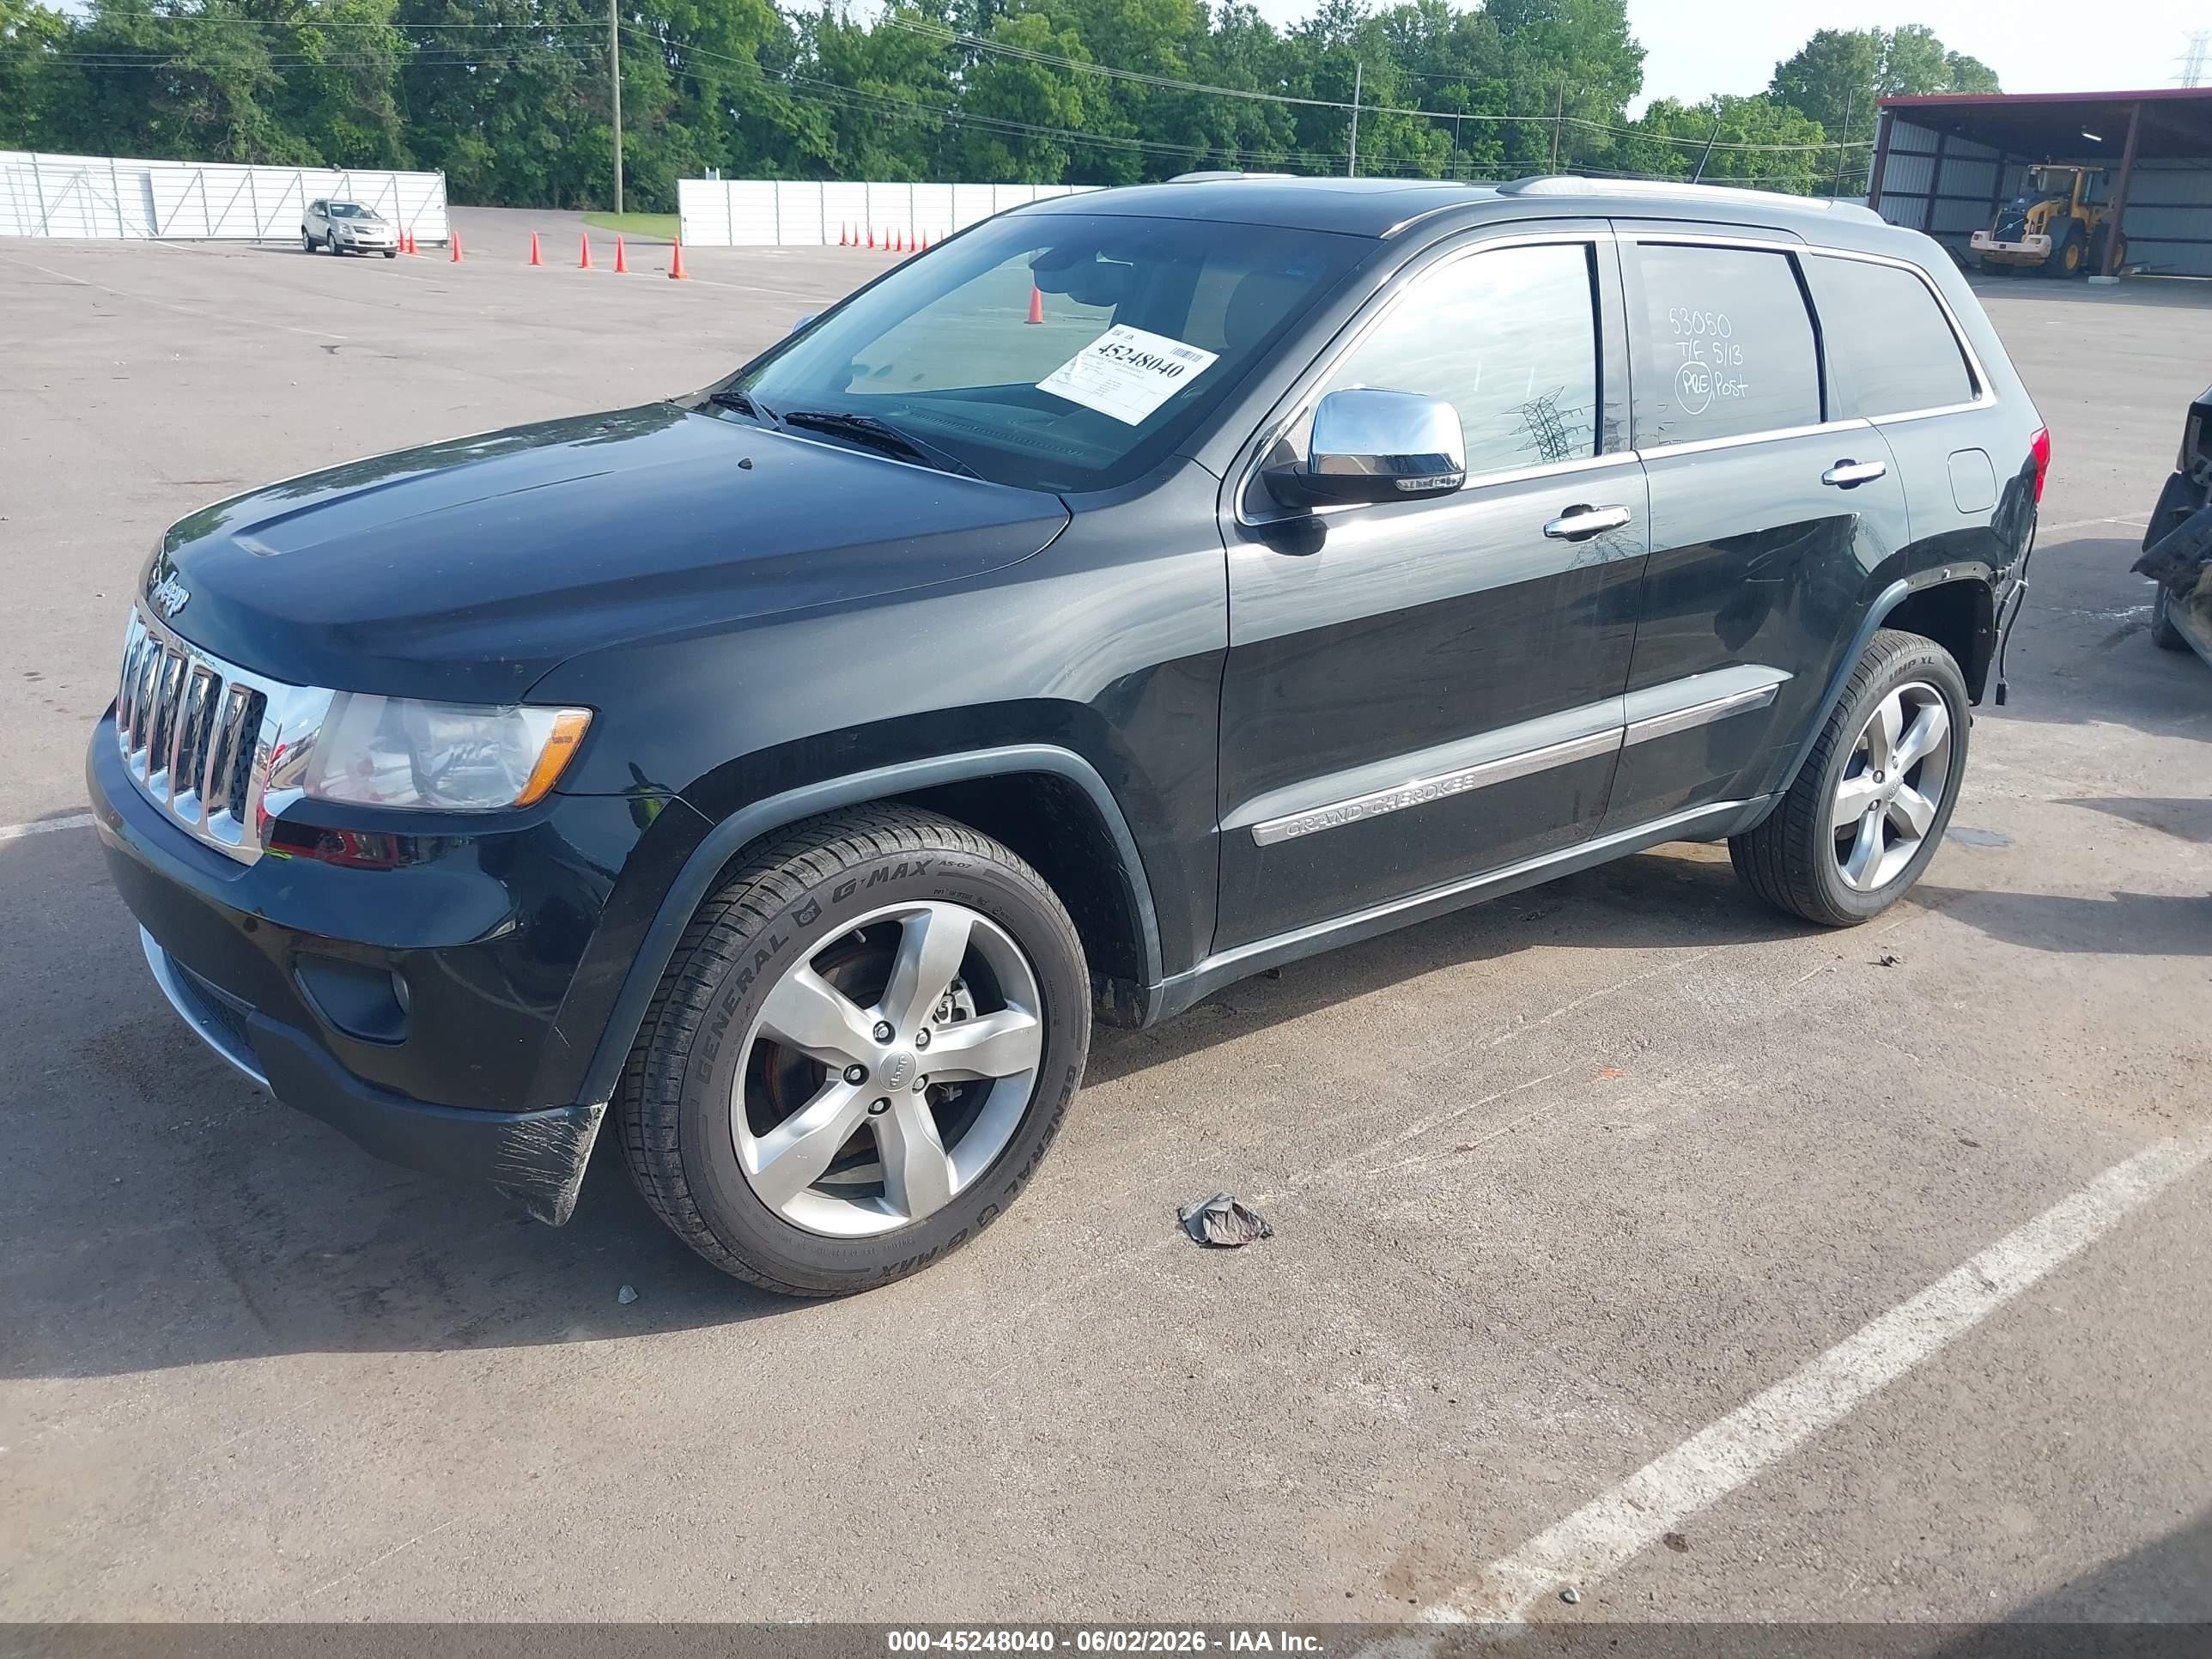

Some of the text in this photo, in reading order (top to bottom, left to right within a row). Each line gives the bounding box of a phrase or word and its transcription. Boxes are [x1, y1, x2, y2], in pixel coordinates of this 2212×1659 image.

[1669, 307, 1732, 338] 53050
[1098, 343, 1184, 378] 45248040
[155, 570, 191, 618] Jeep
[1286, 774, 1475, 836] GRAND CHEROKEE
[696, 933, 790, 1085] GENERAL
